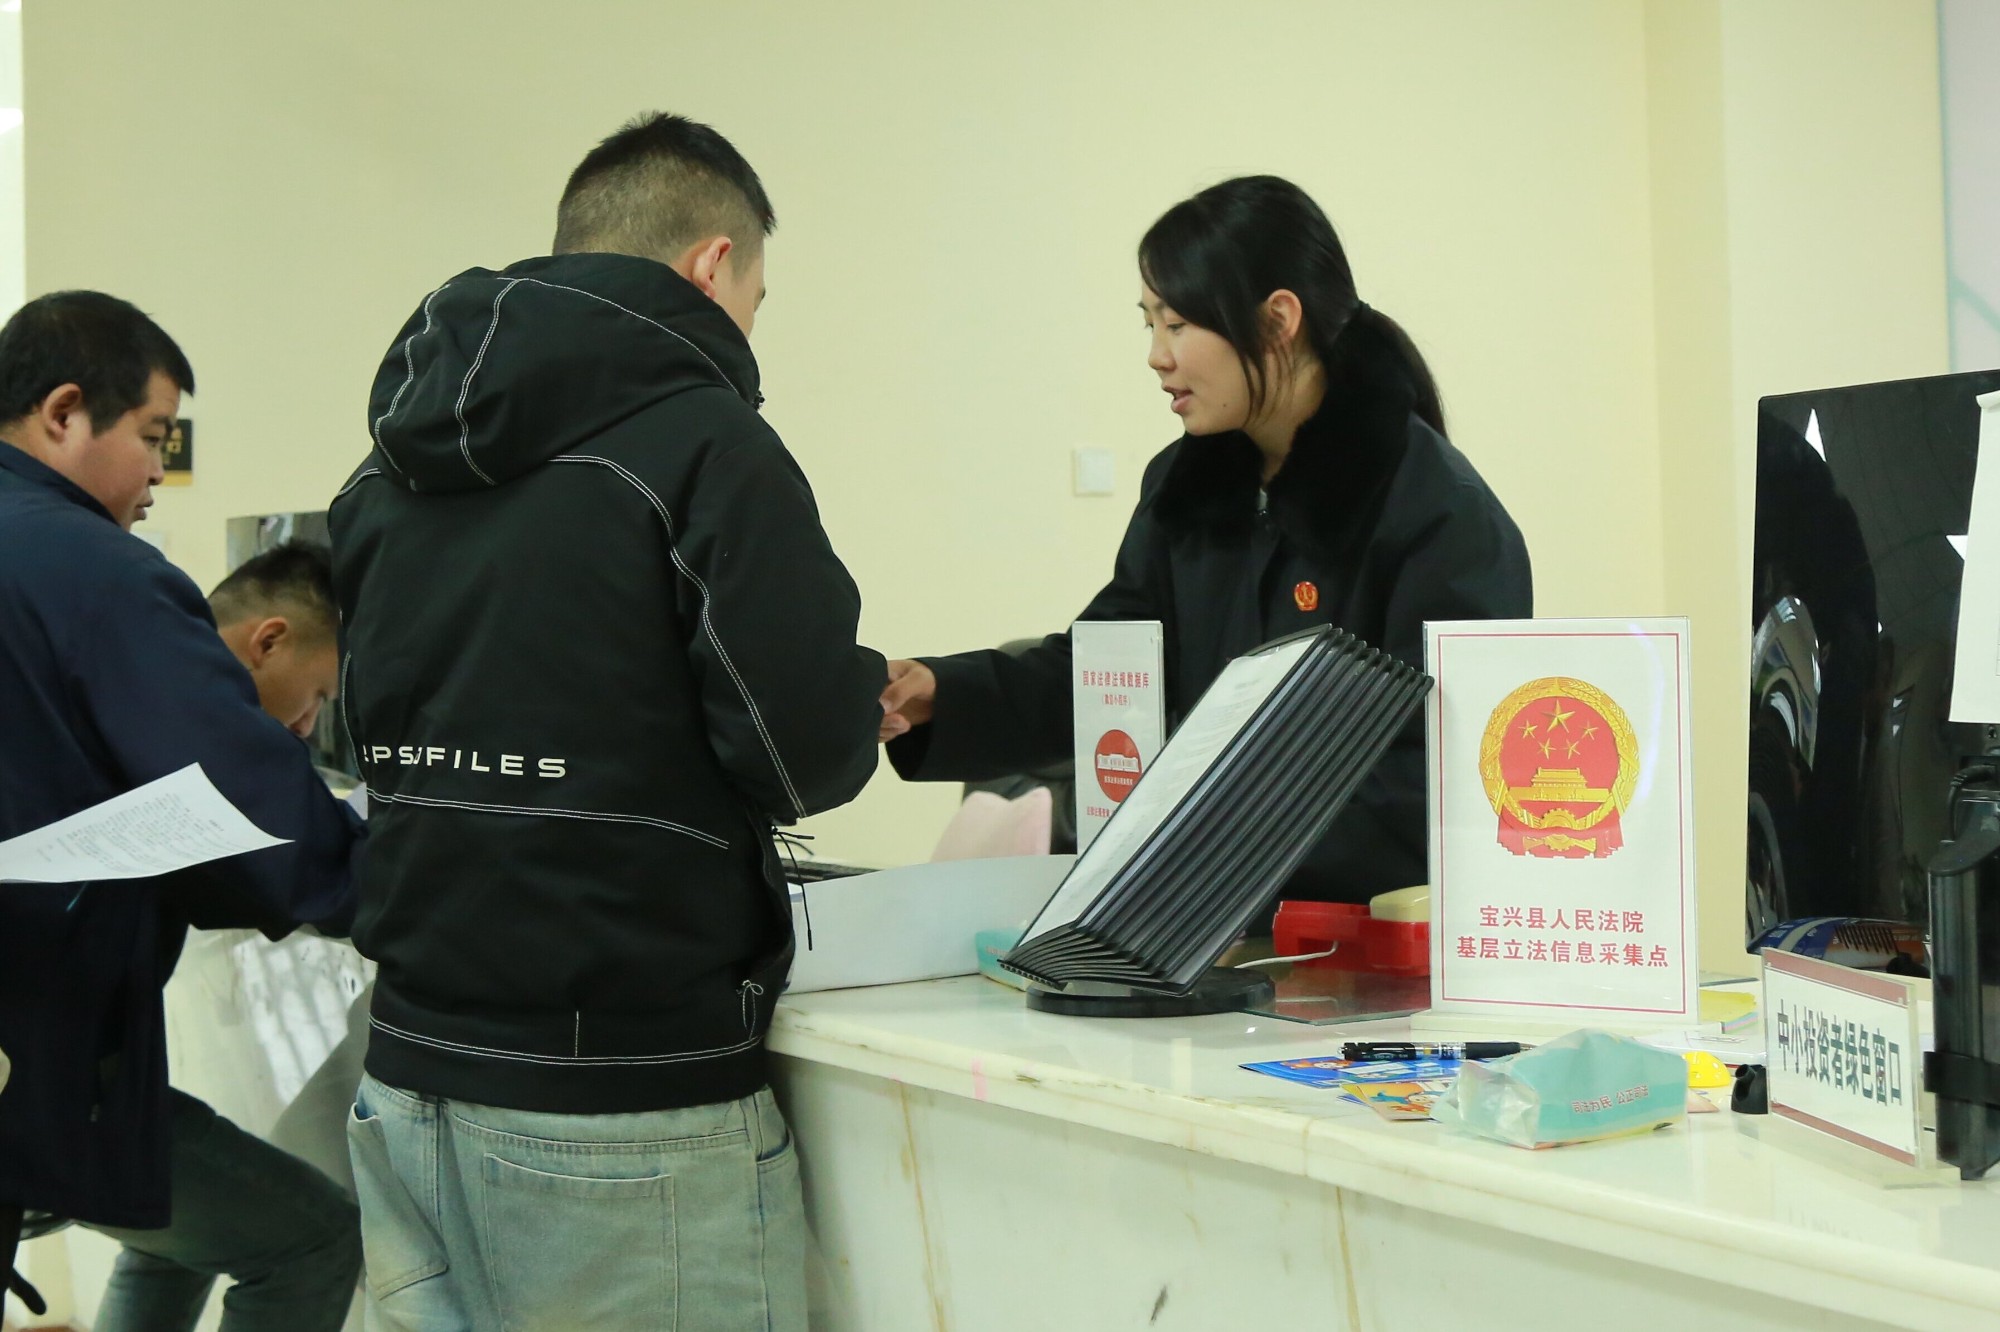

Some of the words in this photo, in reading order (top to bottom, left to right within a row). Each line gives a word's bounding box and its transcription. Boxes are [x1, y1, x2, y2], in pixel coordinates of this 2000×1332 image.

[1479, 905, 1644, 933] 宝兴县人民法院
[1457, 936, 1669, 967] 基层立法信息采集点
[1777, 998, 1902, 1107] 中小投资者绿色窗口
